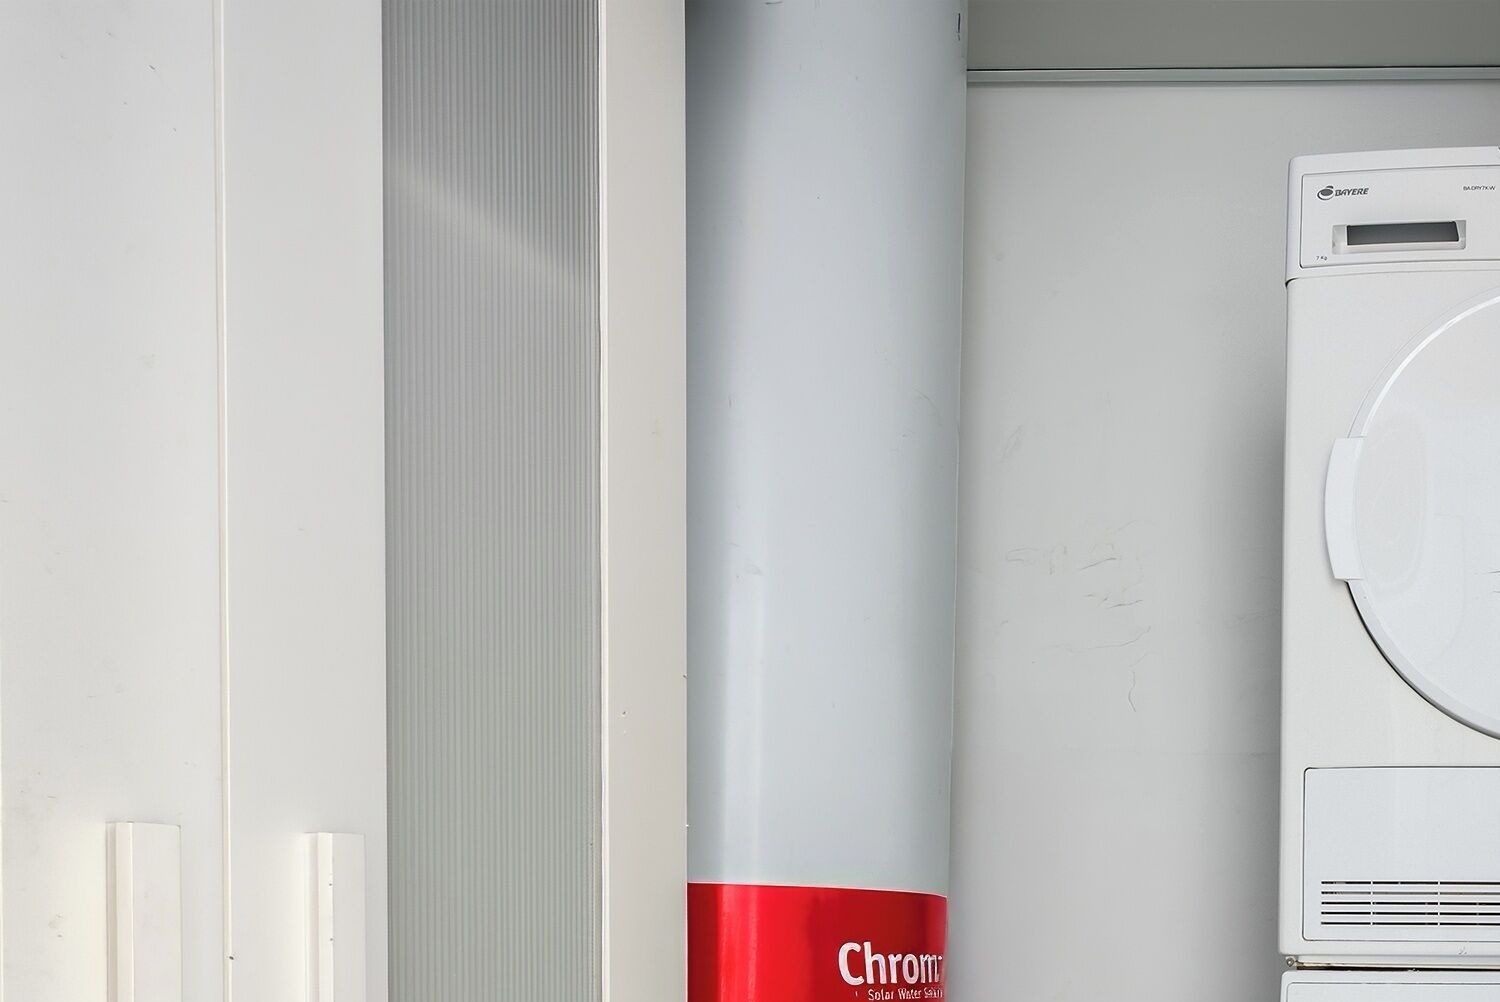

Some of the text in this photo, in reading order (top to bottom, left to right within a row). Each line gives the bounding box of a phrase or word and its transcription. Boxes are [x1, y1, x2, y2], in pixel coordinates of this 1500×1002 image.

[1334, 187, 1369, 197] BAYERE
[838, 941, 943, 985] Chrom
[868, 988, 894, 1001] Solar
[898, 987, 921, 1000] Water
